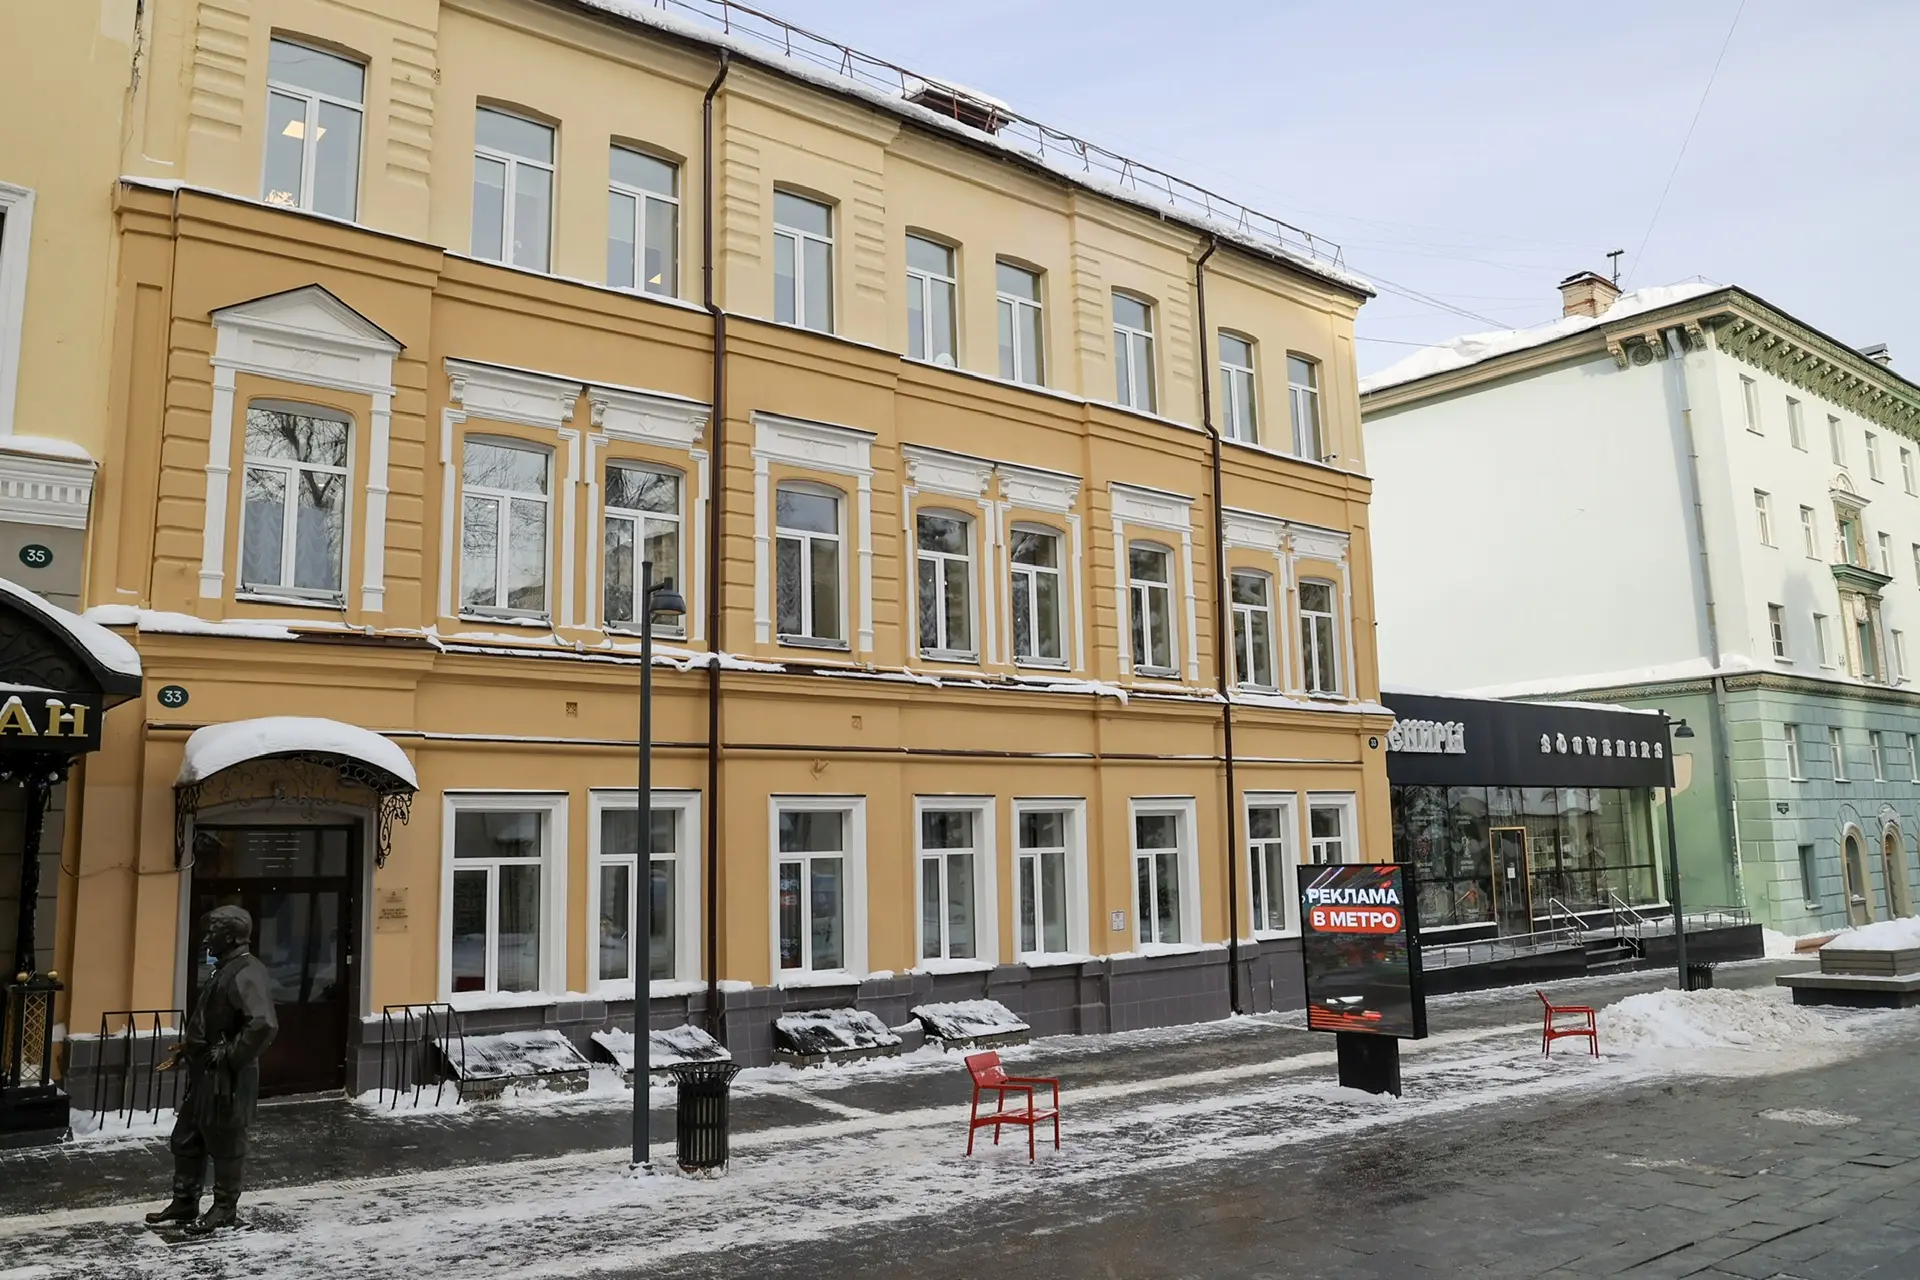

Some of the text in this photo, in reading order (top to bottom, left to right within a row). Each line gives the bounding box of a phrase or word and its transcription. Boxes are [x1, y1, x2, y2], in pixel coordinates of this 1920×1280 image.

[27, 549, 46, 563] 35
[164, 690, 182, 703] 33
[1385, 719, 1466, 754] ЕНИРЫ
[1540, 732, 1663, 759] SOUVENIRS
[1307, 888, 1400, 905] РЕКЛАМА
[1313, 911, 1397, 928] В МЕТРО
